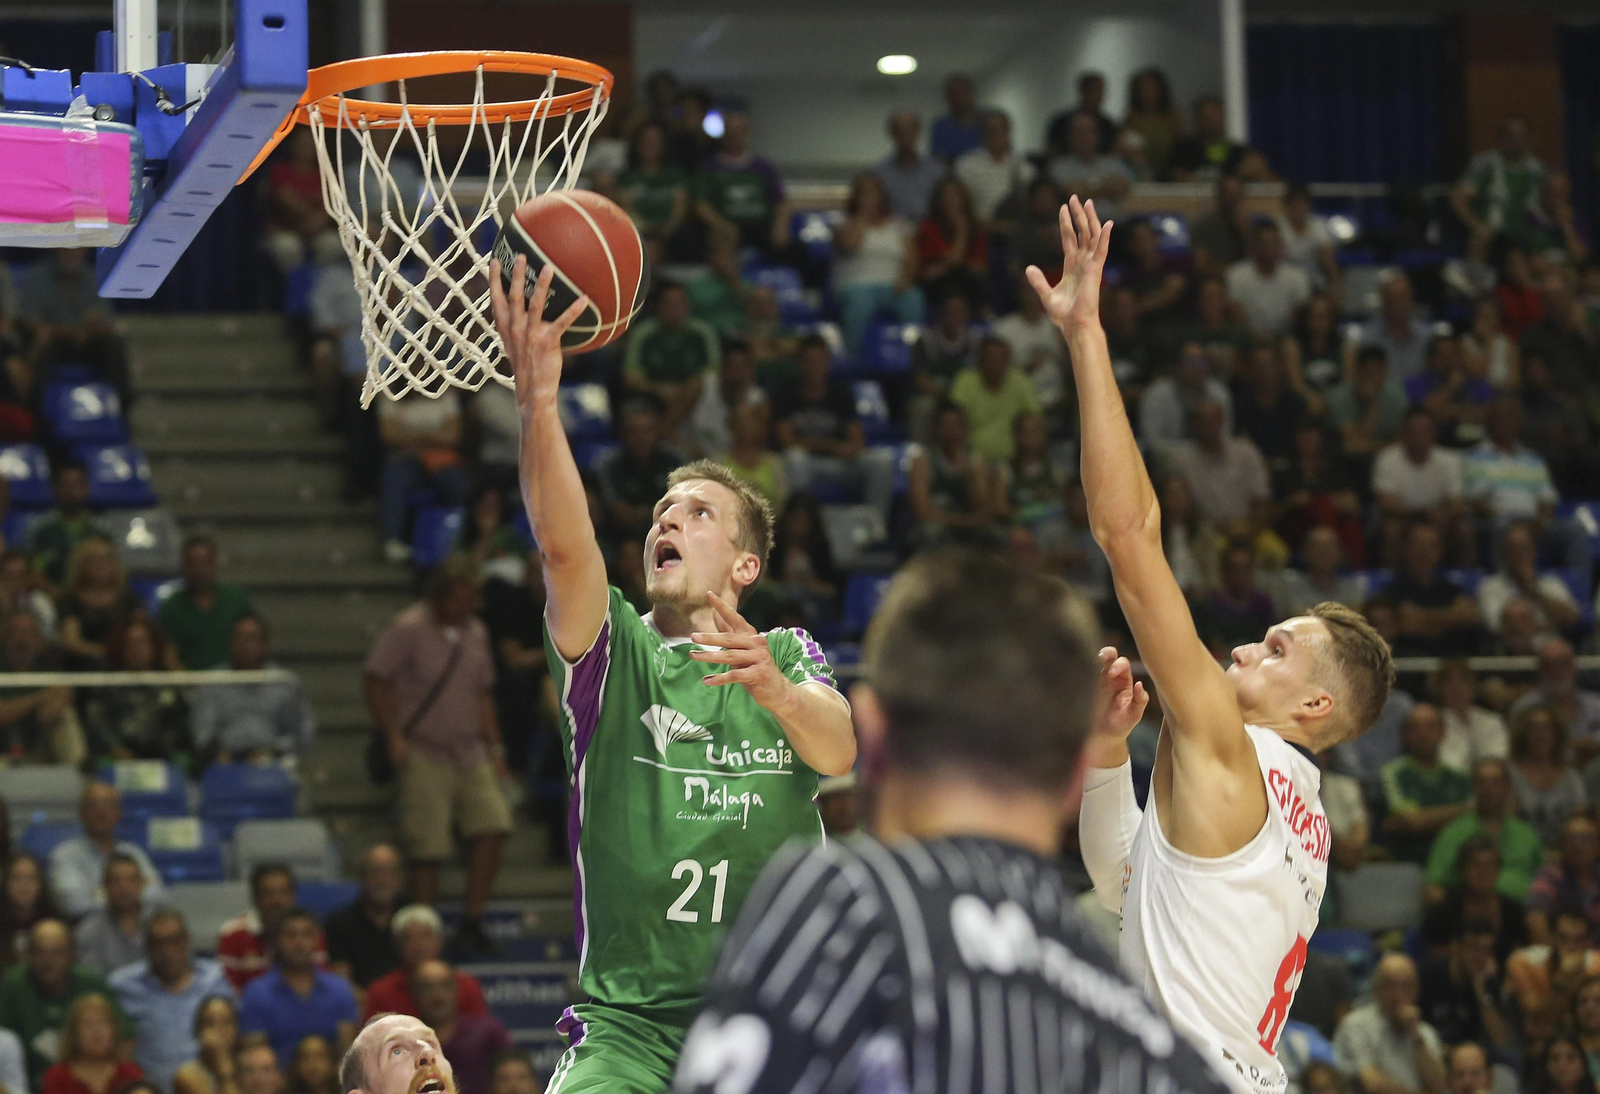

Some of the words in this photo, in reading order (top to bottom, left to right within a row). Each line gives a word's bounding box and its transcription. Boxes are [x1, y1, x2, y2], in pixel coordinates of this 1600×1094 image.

[706, 738, 793, 770] Unicaja
[683, 776, 764, 830] Málaga
[666, 859, 729, 923] 21
